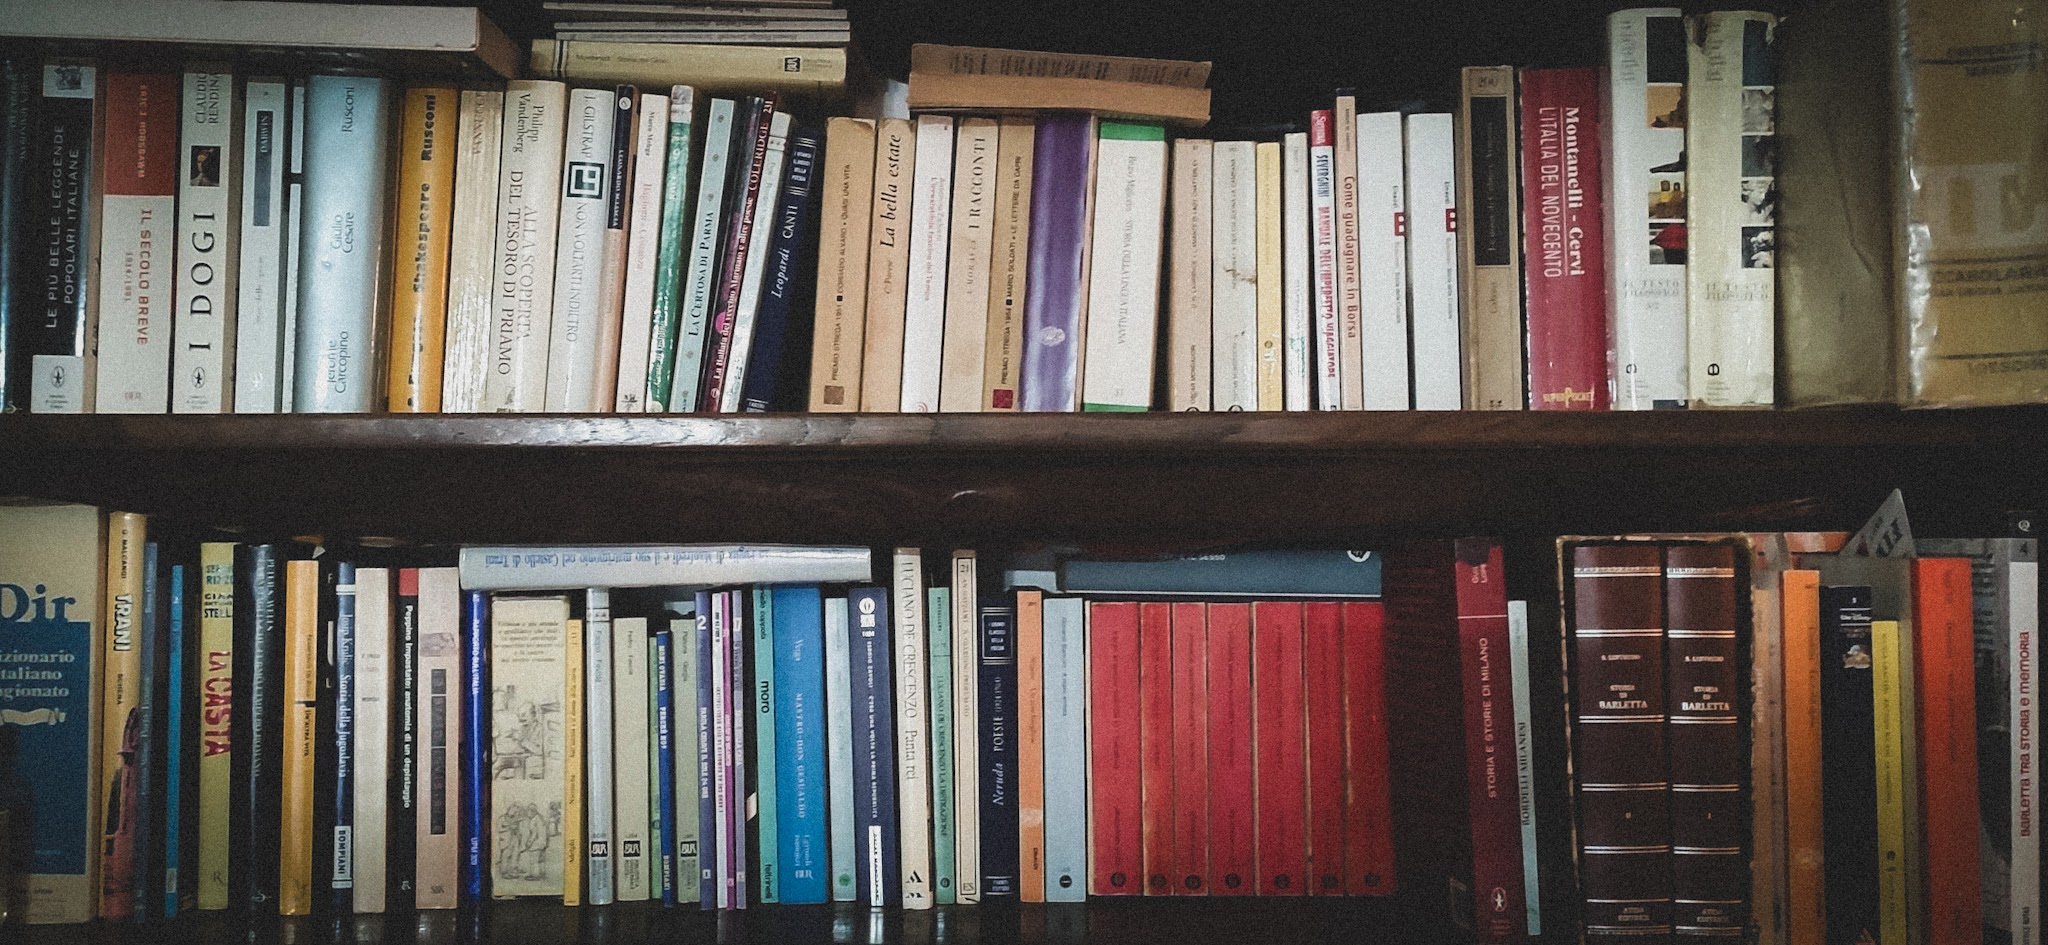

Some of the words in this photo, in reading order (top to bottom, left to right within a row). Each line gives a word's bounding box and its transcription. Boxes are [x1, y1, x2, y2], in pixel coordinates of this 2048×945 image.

[340, 87, 355, 132] Rusconi
[420, 95, 436, 161] Rusconi
[513, 93, 530, 153] Vandenberg
[529, 105, 545, 142] Philipp
[259, 115, 270, 153] DARWIN
[580, 106, 596, 158] GILSTRAP
[1539, 107, 1558, 159] L'ITALIA
[51, 125, 65, 209] LEGGENDE
[748, 122, 770, 191] COLERIDGE
[885, 134, 901, 177] estate
[1565, 107, 1583, 208] Montanelli
[65, 149, 80, 220] ITALIANE
[509, 171, 523, 203] DEL
[968, 137, 986, 217] RACCONTI
[1316, 154, 1330, 198] SEVERGNINI
[1343, 176, 1357, 209] Come
[1541, 165, 1560, 190] DEL
[140, 210, 153, 224] IL
[575, 202, 588, 230] NON
[838, 227, 847, 255] ALVARO
[843, 165, 851, 180] VITA
[880, 184, 898, 220] bella
[48, 216, 61, 266] BELLE
[330, 214, 343, 250] Giulio
[342, 212, 355, 253] Cesare
[412, 183, 430, 293] Shakespeare
[503, 208, 520, 276] TESORO
[522, 205, 538, 250] ALLA
[700, 211, 715, 250] PARMA
[880, 228, 897, 247] La
[1542, 196, 1562, 278] NOVECENTO
[63, 227, 77, 304] POPOLARI
[138, 230, 151, 289] SECOLO
[190, 211, 215, 317] DOGI
[771, 248, 792, 298] Leopardi
[782, 205, 799, 238] CANTI
[1008, 242, 1016, 272] SOLDATI
[1342, 213, 1358, 283] guadagnare
[1569, 227, 1585, 275] Cervi
[46, 273, 60, 300] PIÙ
[502, 281, 516, 299] DI
[517, 254, 535, 340] SCOPERTA
[690, 268, 708, 319] CERTOSA
[1006, 274, 1014, 297] MARIO
[1346, 288, 1359, 299] in
[45, 317, 58, 328] LE
[136, 296, 149, 345] BREVE
[689, 321, 700, 336] LA
[1346, 305, 1359, 338] Borsa
[189, 342, 211, 352] I
[497, 308, 515, 375] PRIAMO
[1002, 326, 1011, 354] STREGA
[337, 331, 351, 394] Carcopino
[120, 540, 128, 580] MALCANGI
[485, 555, 508, 568] Trani
[512, 554, 521, 568] di
[524, 554, 559, 567] Castello
[901, 562, 915, 619] LUCIANO
[113, 593, 133, 652] TRANI
[340, 613, 352, 635] Josip
[403, 605, 414, 641] Peppino
[697, 615, 707, 630] 2
[902, 624, 914, 640] DE
[1, 667, 62, 680] taliano
[208, 650, 231, 671] LA
[404, 643, 413, 690] Impastato:
[1479, 637, 1489, 681] MILANO
[340, 674, 351, 701] Storia
[760, 680, 770, 714] moro
[903, 644, 917, 718] CRESCENZO
[936, 675, 946, 711] LUCIANO
[1481, 684, 1491, 697] DI
[204, 677, 231, 757] CASTA
[339, 706, 351, 728] della
[404, 691, 412, 731] anatomia
[938, 713, 946, 723] DE
[1483, 699, 1493, 742] STORIE
[1599, 701, 1648, 710] BARLETTA
[1682, 702, 1730, 711] BARLETTA
[404, 733, 412, 741] di
[404, 743, 410, 755] un
[868, 730, 876, 750] VOLTA
[904, 730, 917, 761] Panta
[938, 726, 946, 771] CRESCENZO
[993, 716, 1004, 752] POESIE
[1486, 745, 1494, 753] E
[337, 730, 351, 777] Jugoslavia
[869, 761, 877, 780] PRIMA
[870, 751, 876, 759] LA
[905, 765, 919, 780] rei
[402, 758, 412, 808] depistaggio
[939, 773, 947, 783] LA
[991, 762, 1005, 806] Neruda
[1486, 756, 1498, 798] STORIA
[1519, 775, 1531, 826] BORDELLI
[337, 829, 348, 876] BOMPIANI
